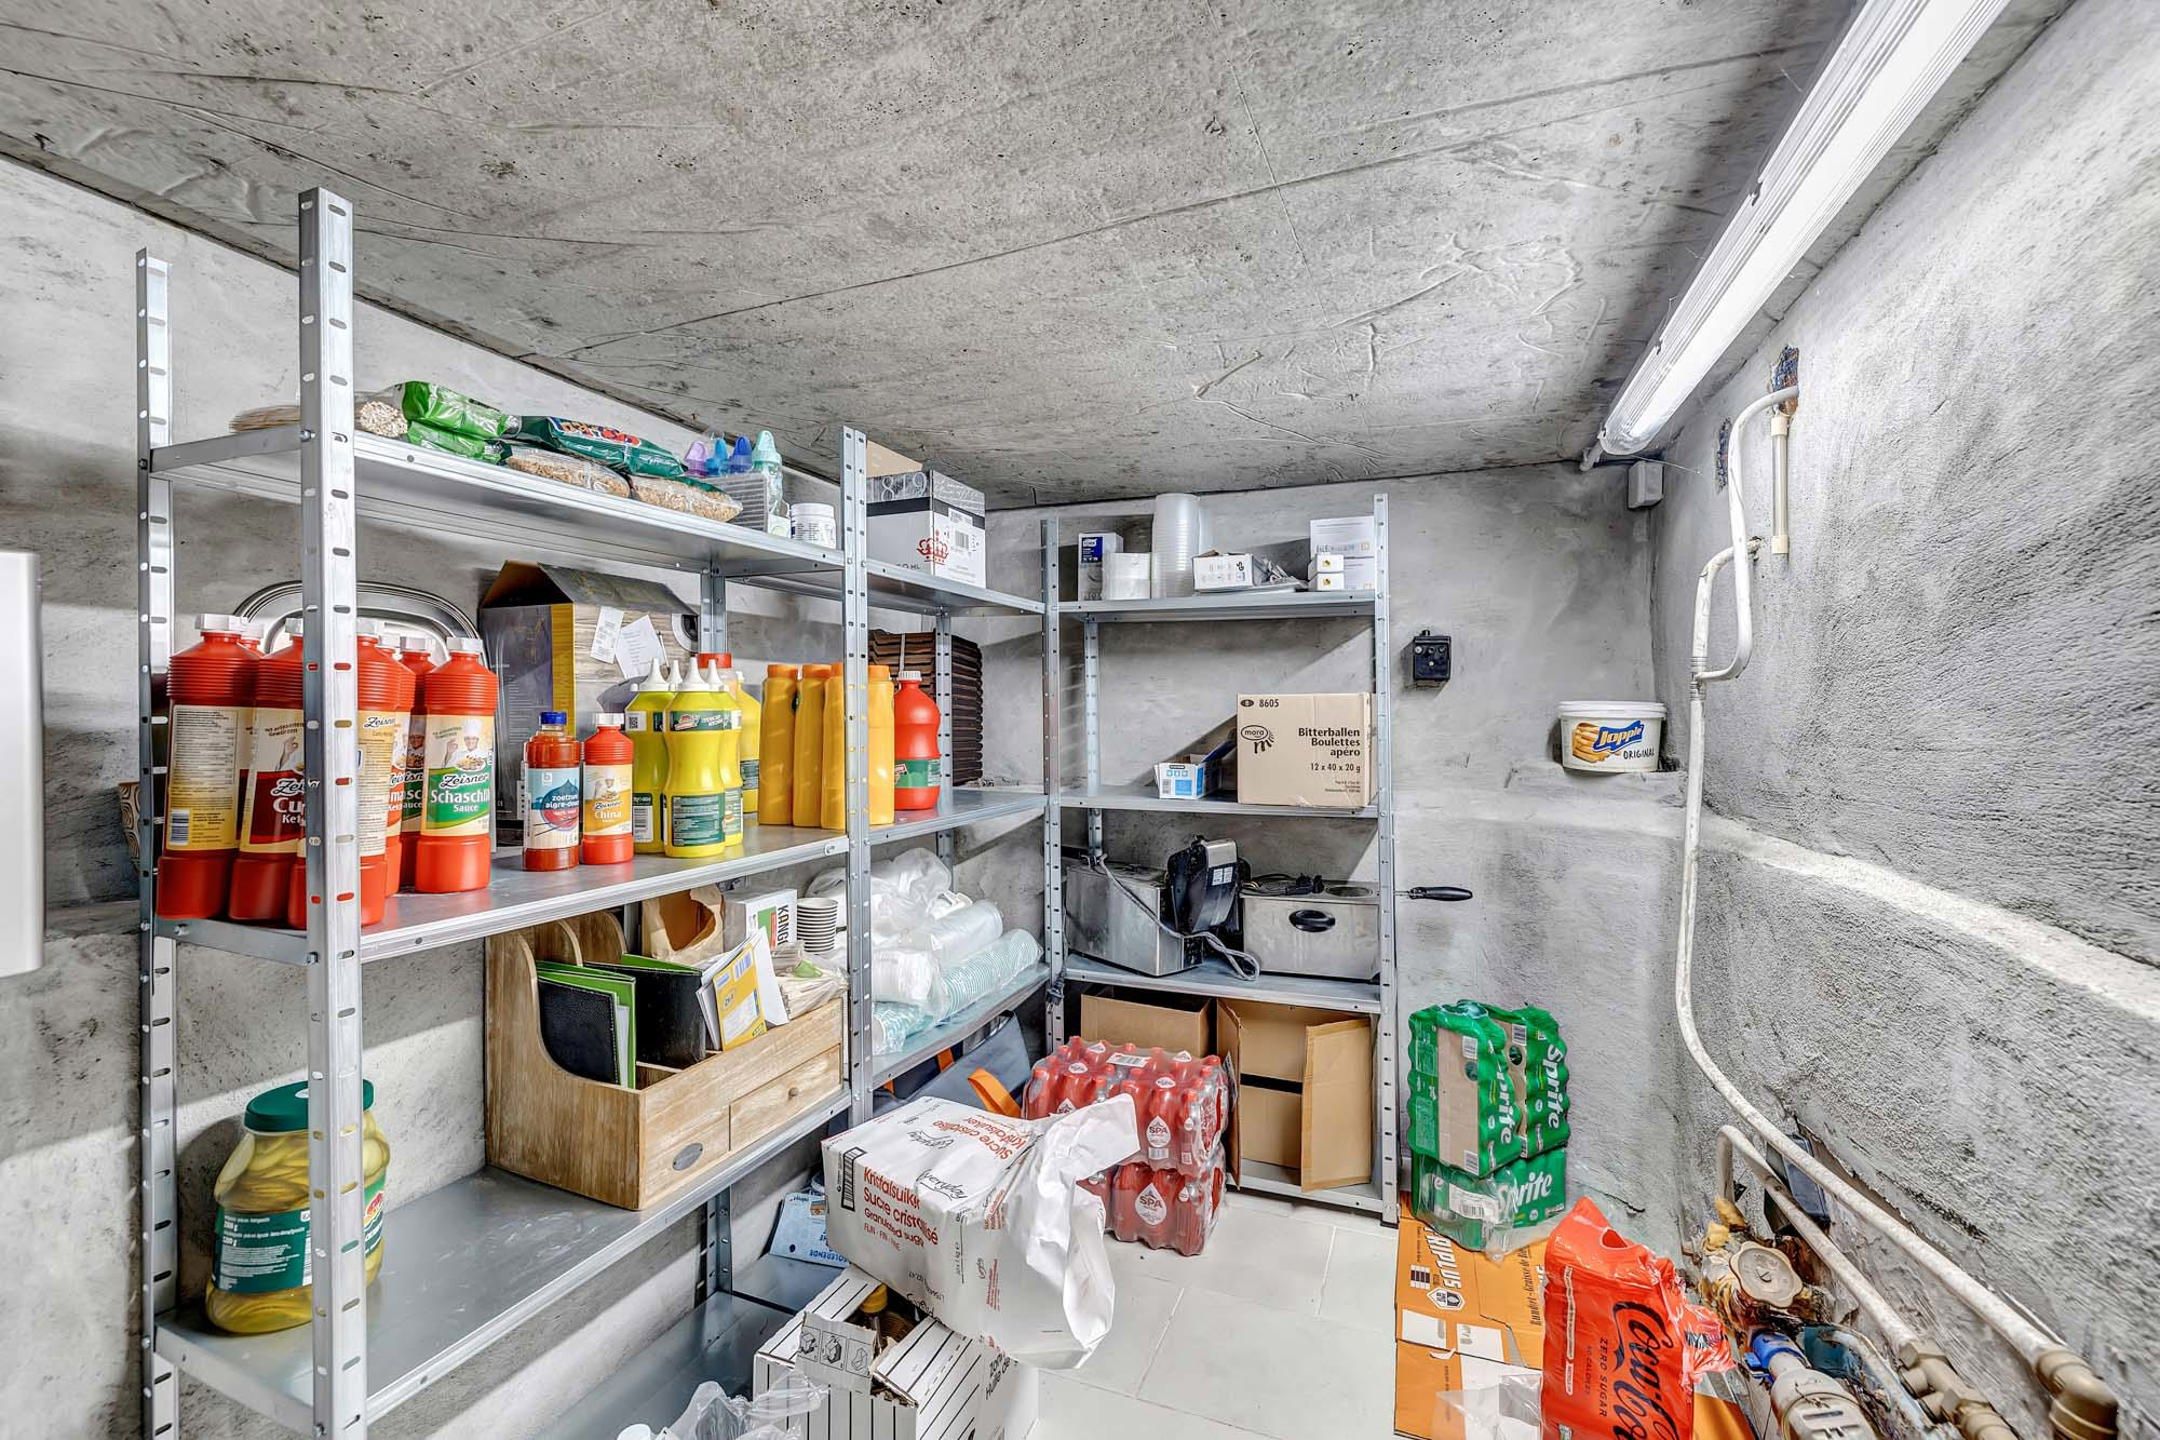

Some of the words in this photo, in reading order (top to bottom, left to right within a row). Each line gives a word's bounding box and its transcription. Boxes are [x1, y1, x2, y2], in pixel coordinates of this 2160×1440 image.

[1259, 699, 1279, 708] 8605
[1298, 728, 1360, 737] Bitterballen
[1311, 738, 1360, 747] Boulettes
[1330, 747, 1360, 758] apéro
[1623, 747, 1655, 760] ORIGINAL
[1311, 763, 1319, 771] 12
[1327, 763, 1336, 771] 40
[1345, 763, 1354, 771] 20
[440, 773, 489, 788] Zeisner
[453, 804, 479, 812] Sauce
[595, 810, 622, 819] China
[778, 904, 790, 945] KANG
[1543, 1044, 1563, 1128] Sprite
[1496, 1064, 1516, 1144] prite
[1149, 1126, 1168, 1134] SPA
[980, 1135, 1013, 1160] Sucre
[1139, 1195, 1163, 1208] SPA
[1498, 1172, 1553, 1221] Sprite
[1600, 1338, 1608, 1371] ZERO
[1612, 1301, 1681, 1440] Coca-Co
[1599, 1375, 1608, 1417] SUGAR
